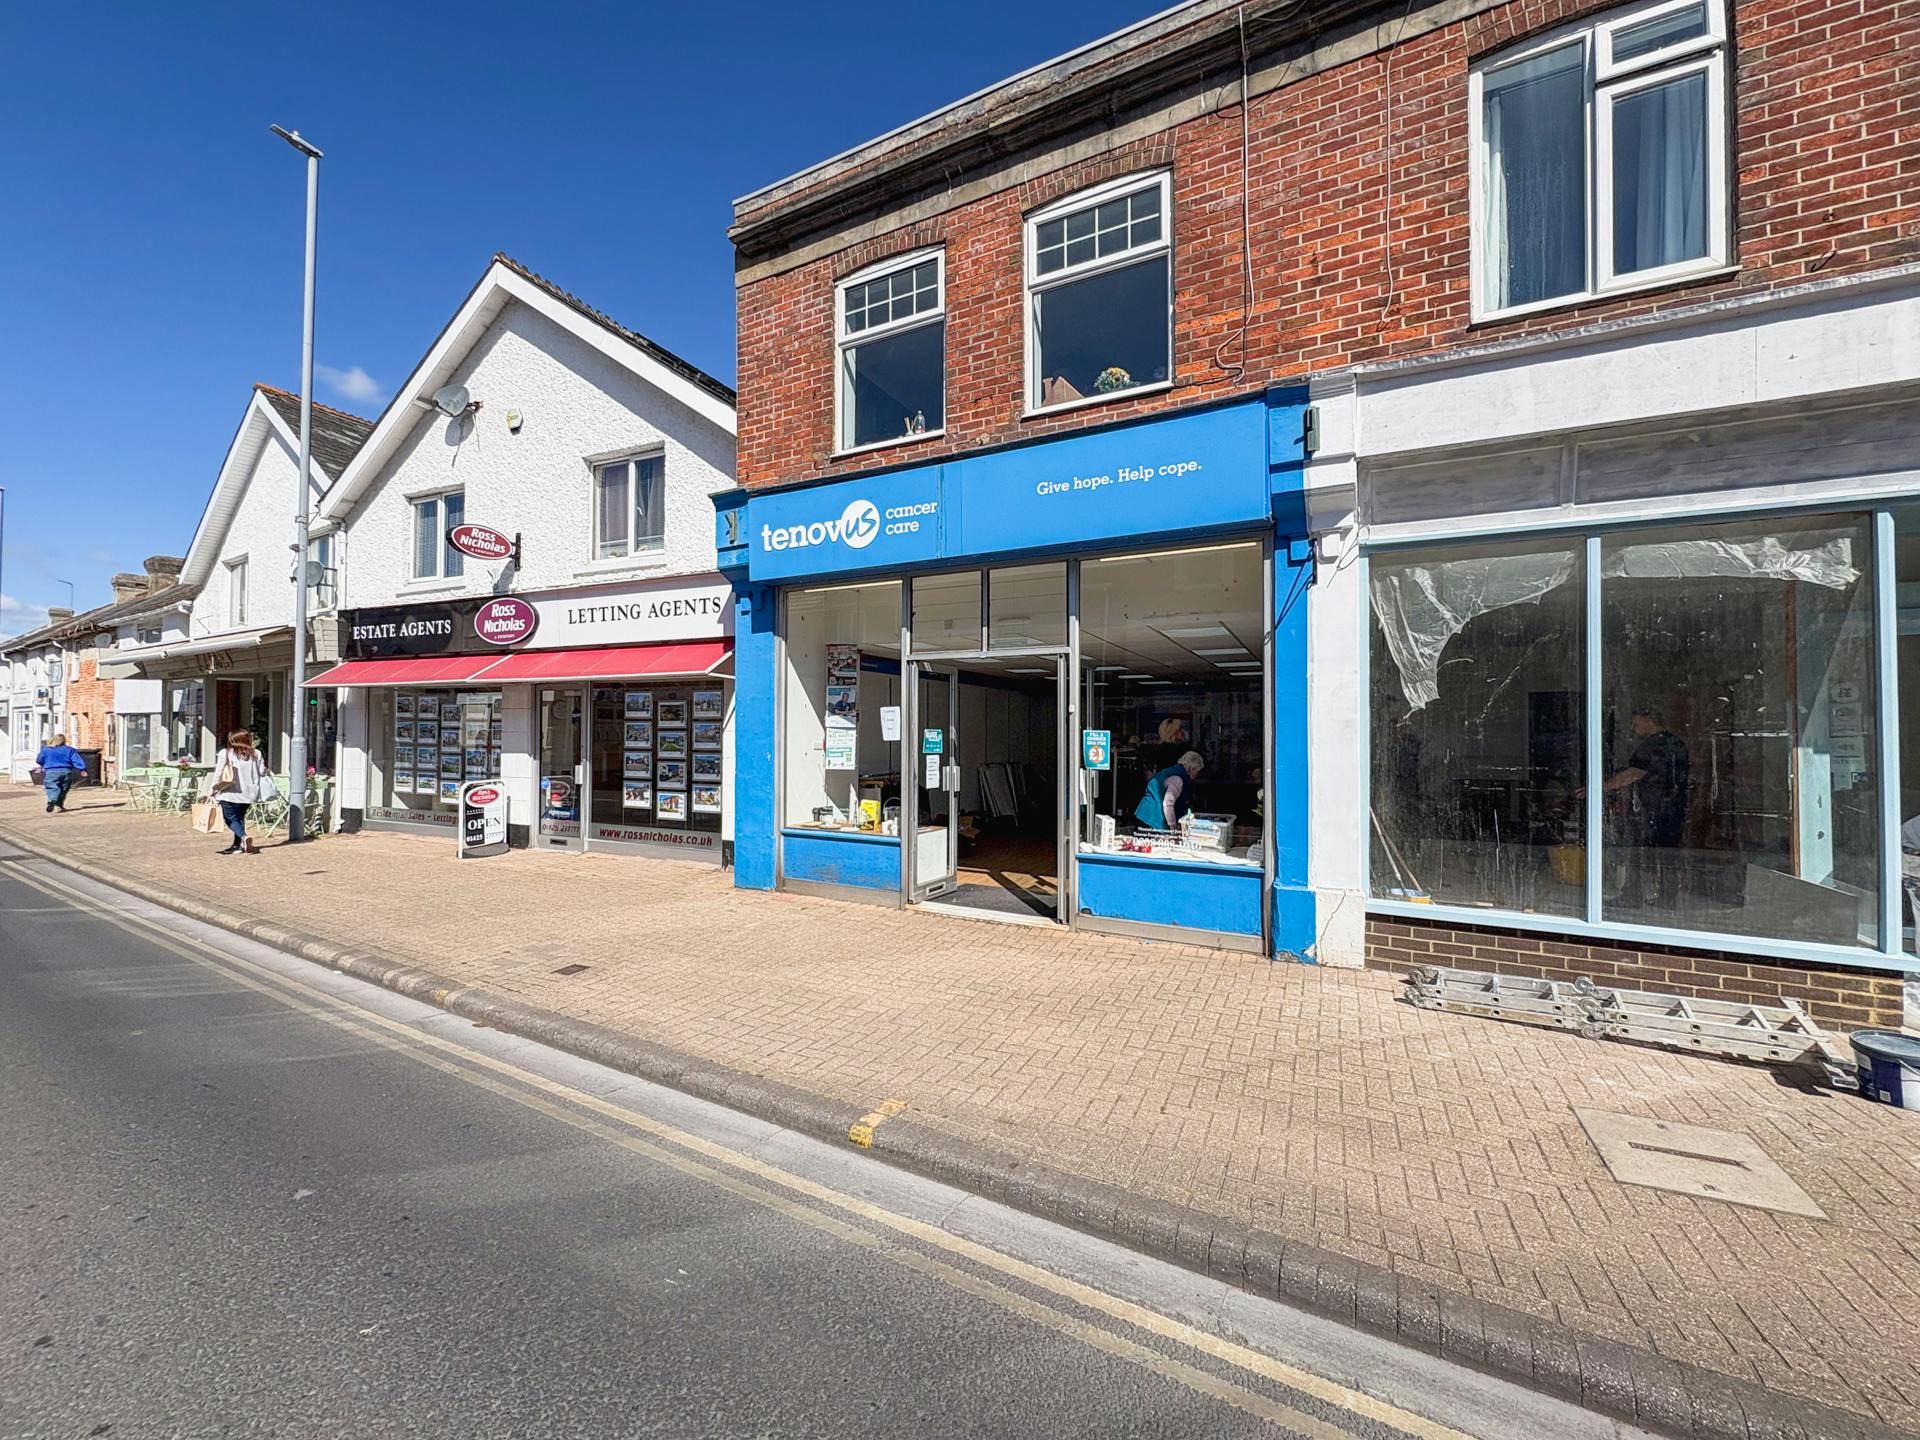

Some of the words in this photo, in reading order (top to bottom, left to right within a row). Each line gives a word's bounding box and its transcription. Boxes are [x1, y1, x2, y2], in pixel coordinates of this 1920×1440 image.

[1036, 482, 1070, 495] Give
[1073, 477, 1114, 490] hope.
[1118, 466, 1154, 482] Help
[1158, 461, 1202, 477] cope.
[885, 502, 938, 519] cancer
[471, 528, 496, 542] Ross
[761, 504, 879, 552] tenovus
[885, 520, 920, 535] care
[459, 534, 506, 554] Nicholas
[491, 603, 516, 617] Ross
[568, 604, 641, 624] LETTING
[648, 596, 721, 618] AGENTS
[353, 623, 396, 640] ESTATE
[400, 619, 452, 637] AGENTS
[483, 618, 526, 633] Nicholas
[433, 813, 458, 824] Letting
[467, 816, 501, 831] OPEN
[599, 828, 713, 847] www.rossnicholas.co.uk
